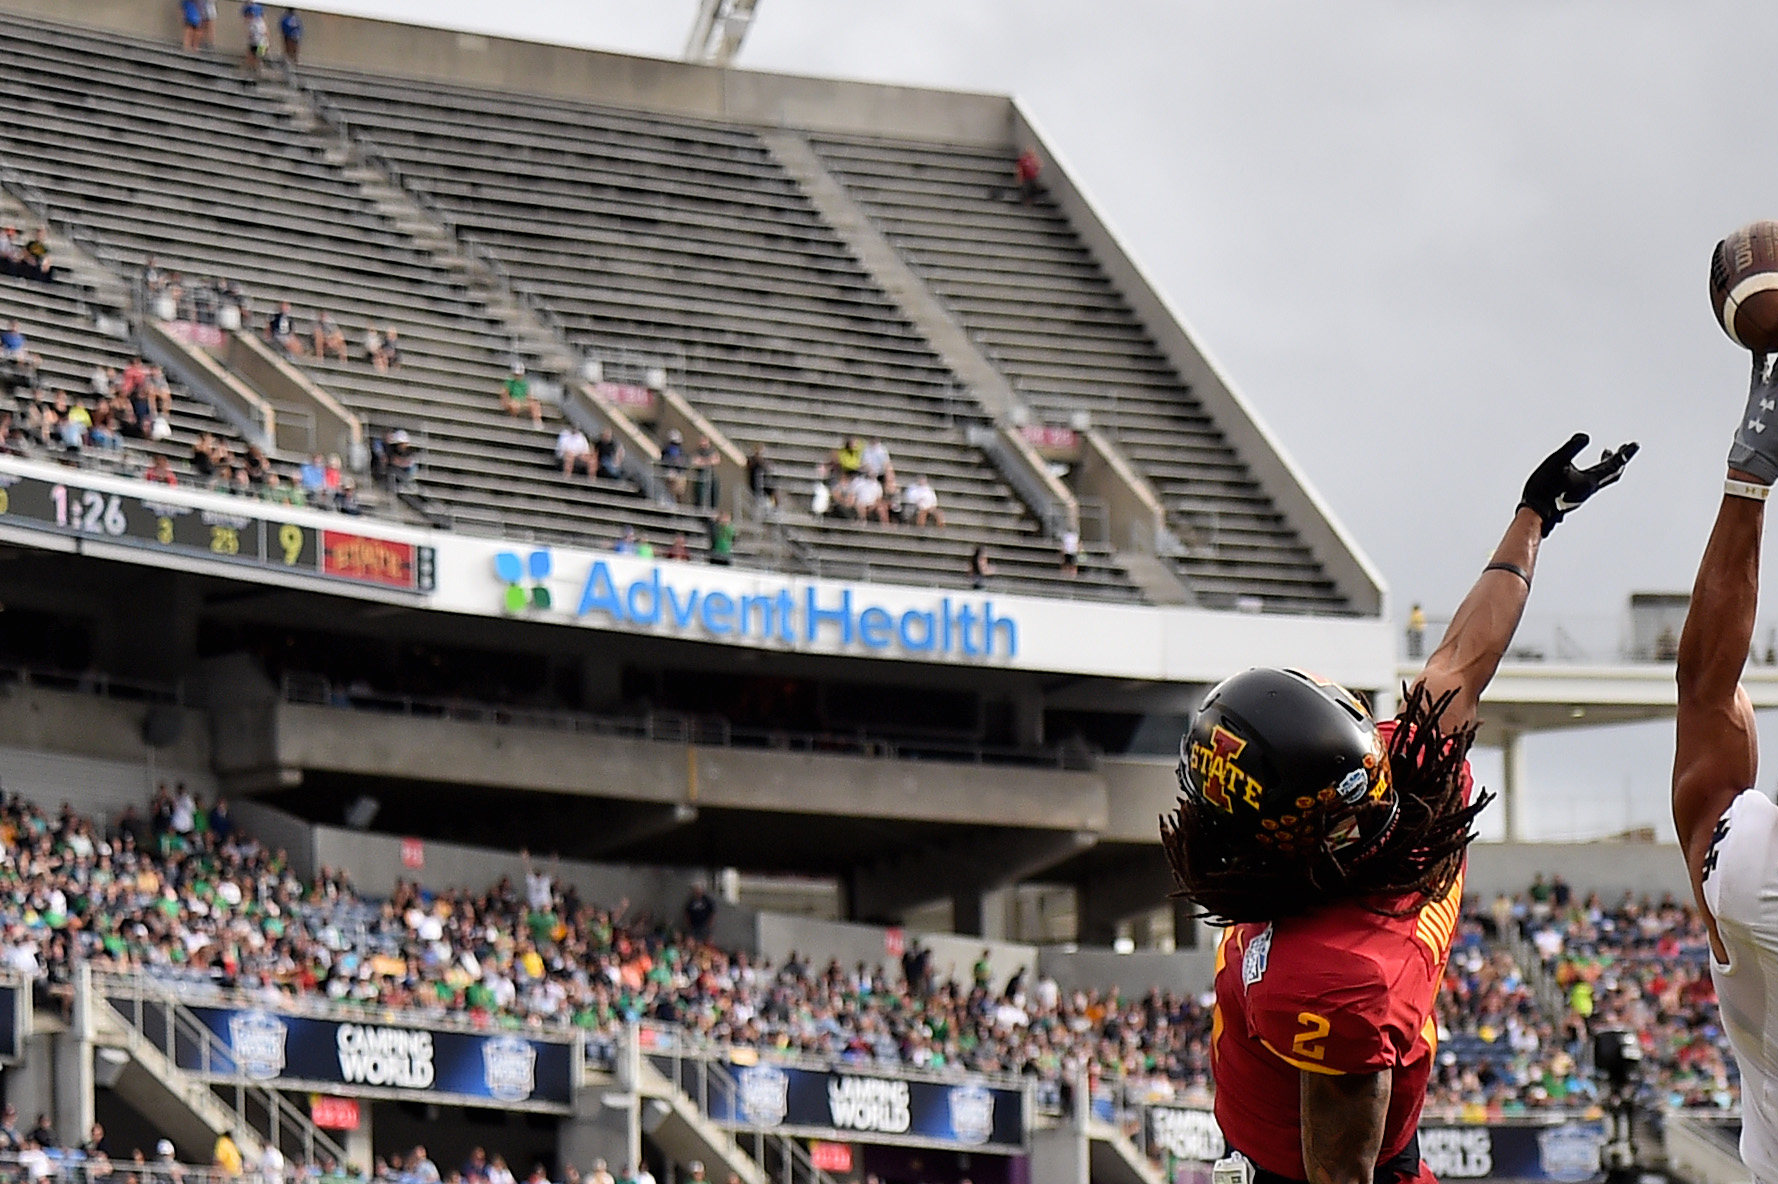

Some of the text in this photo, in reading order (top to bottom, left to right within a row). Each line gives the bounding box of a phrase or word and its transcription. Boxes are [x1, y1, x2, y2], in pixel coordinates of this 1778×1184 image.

[52, 484, 127, 536] 1:26
[279, 524, 304, 566] 9
[577, 560, 1017, 658] AdventHealth
[1191, 741, 1263, 811] STATE
[337, 1023, 434, 1061] CAMPING
[1292, 1012, 1331, 1060] 2
[339, 1051, 435, 1088] WORLD
[829, 1099, 910, 1133] WORLD
